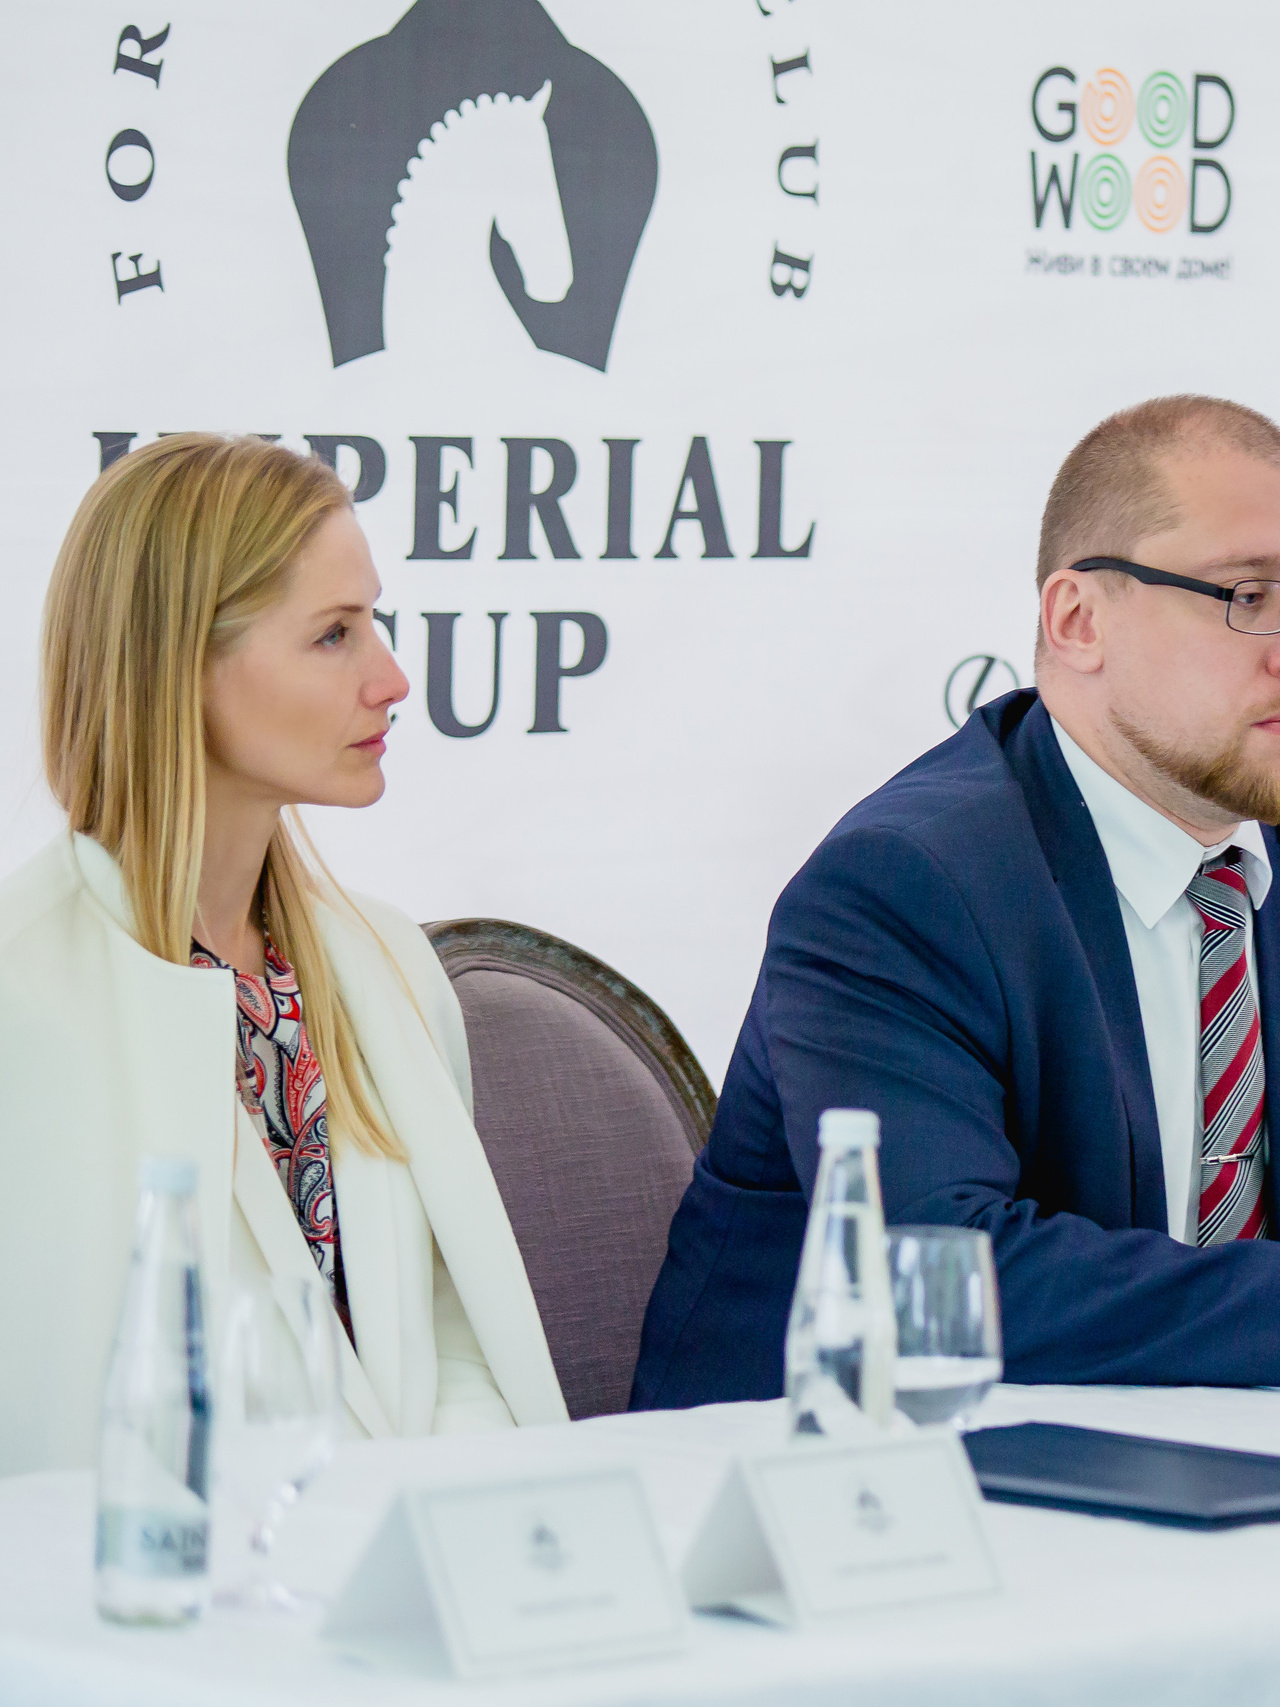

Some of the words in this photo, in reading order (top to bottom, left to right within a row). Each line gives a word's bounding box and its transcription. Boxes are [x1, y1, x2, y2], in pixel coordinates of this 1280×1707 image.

[105, 22, 171, 306] FOR
[755, 0, 820, 300] LUB
[1031, 66, 1236, 149] GOOD
[1030, 150, 1232, 234] WOOD
[373, 607, 609, 739] UP
